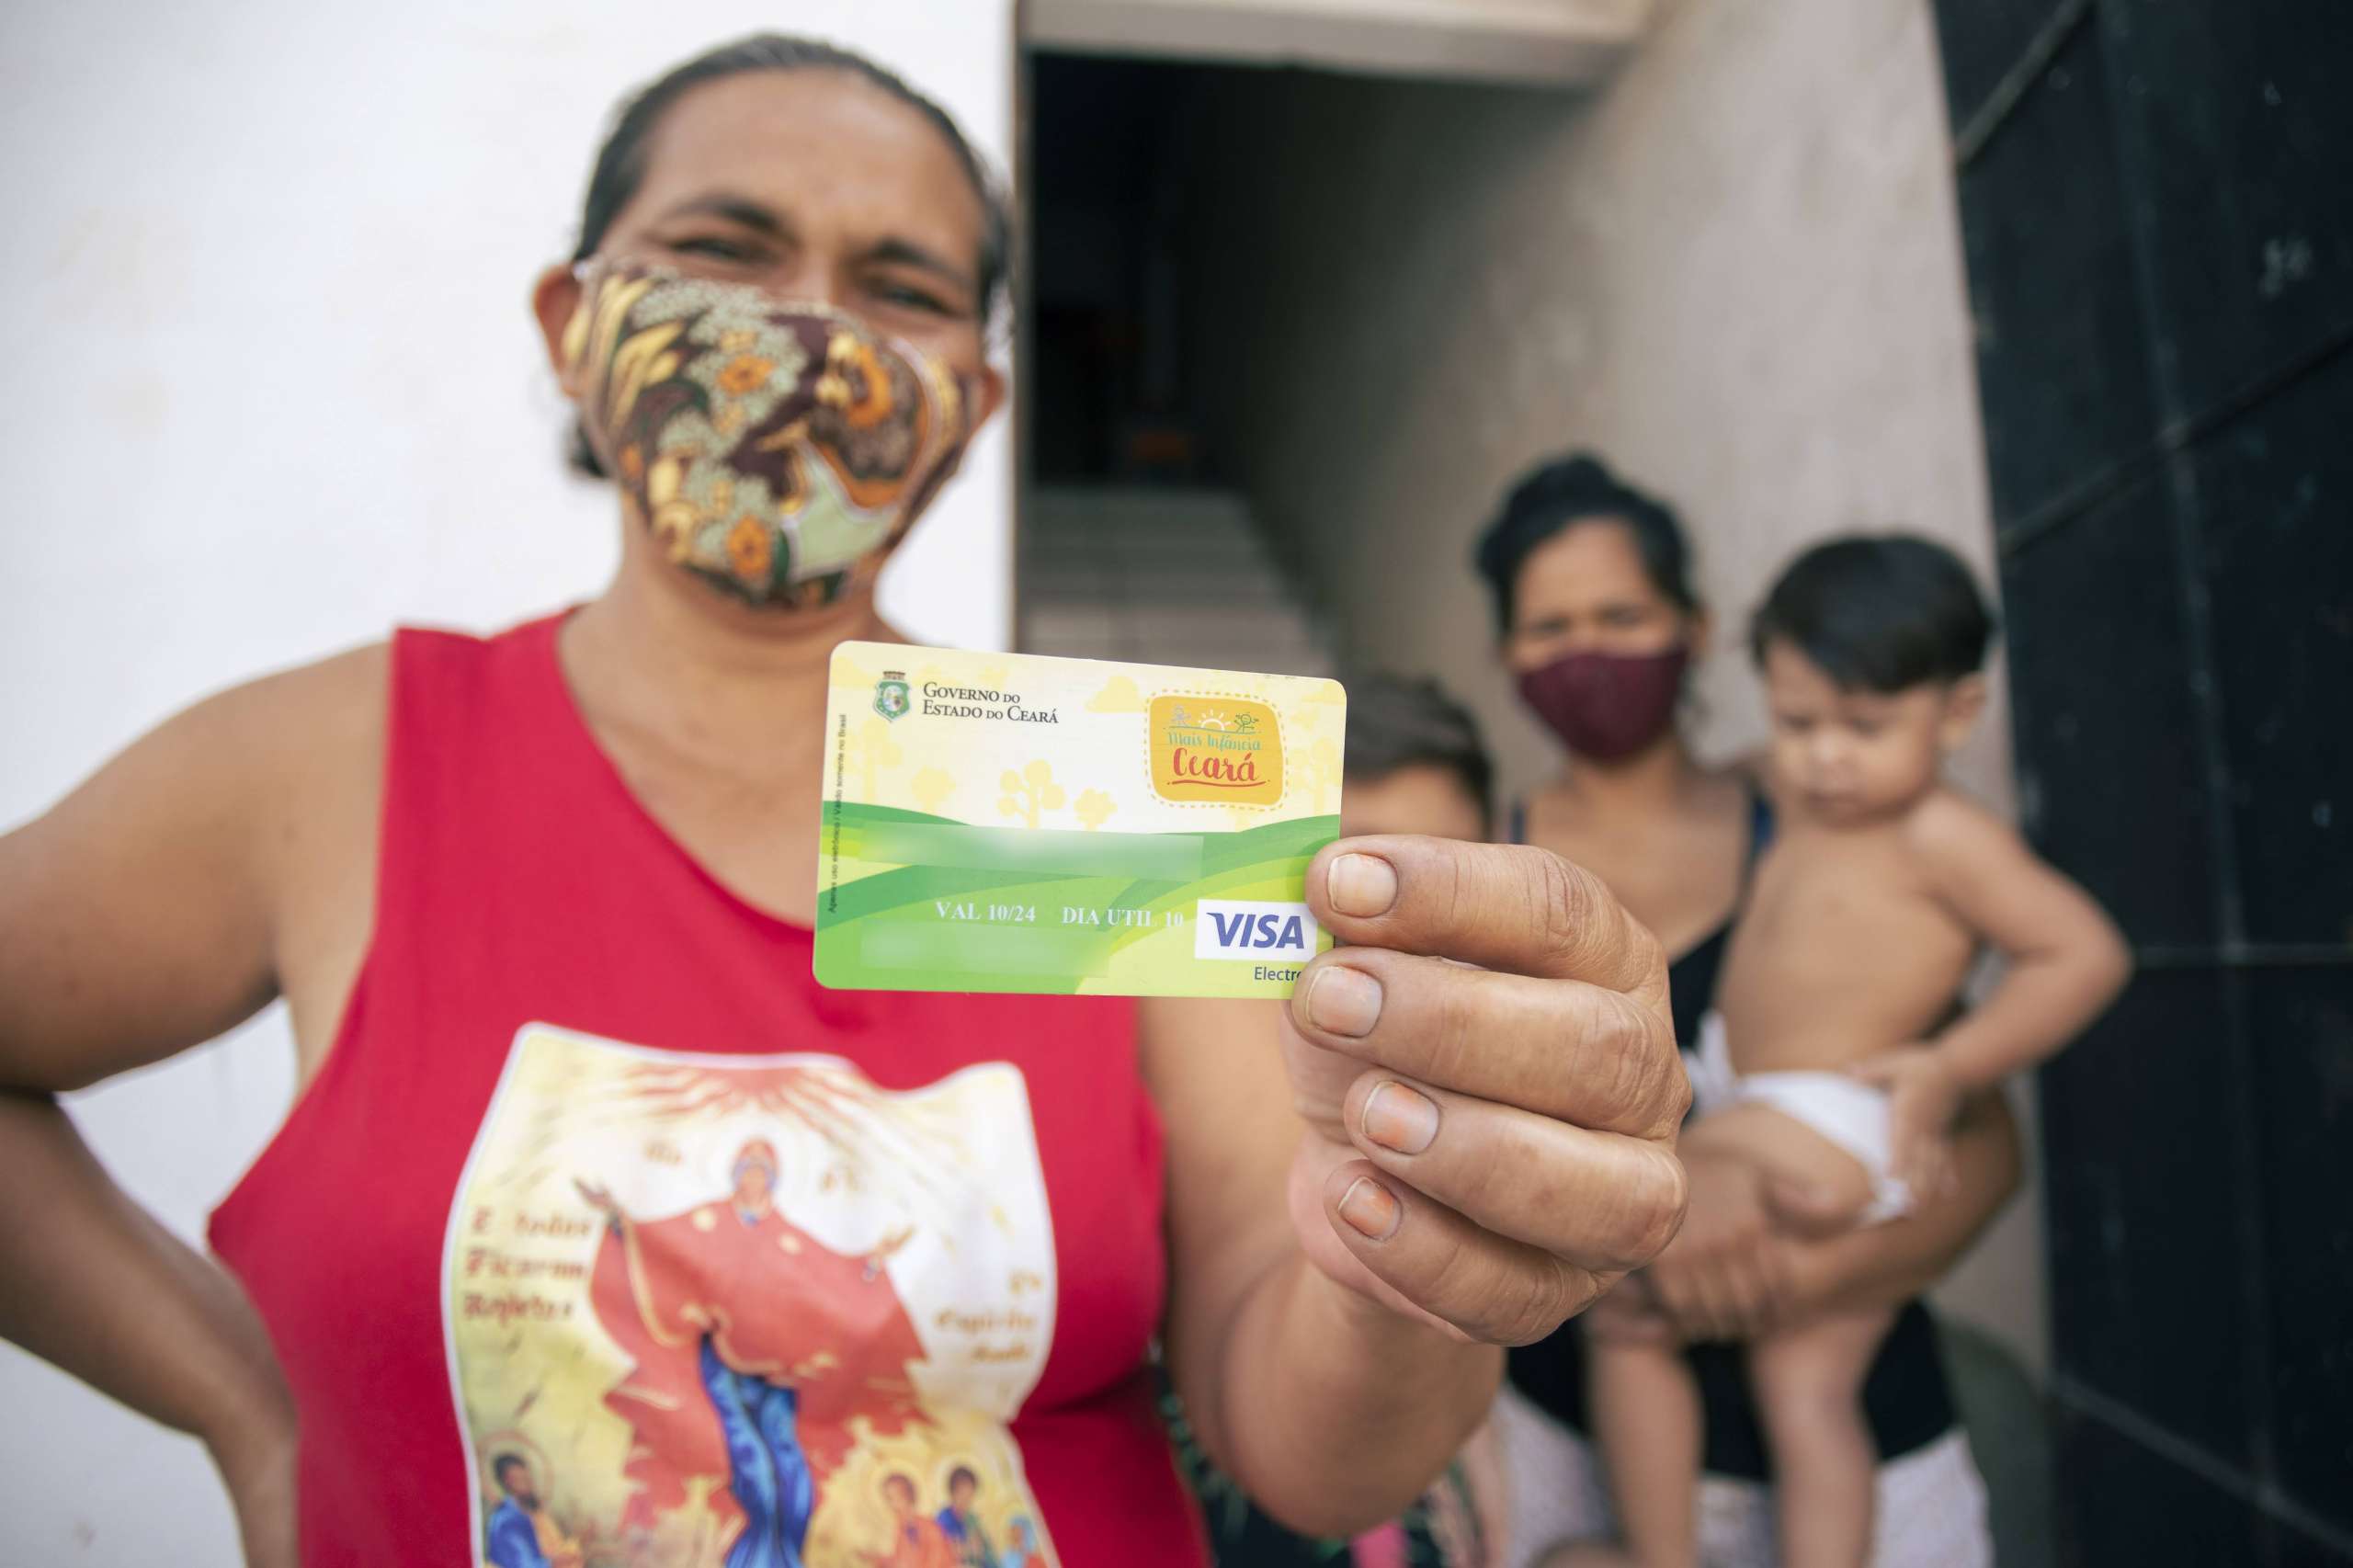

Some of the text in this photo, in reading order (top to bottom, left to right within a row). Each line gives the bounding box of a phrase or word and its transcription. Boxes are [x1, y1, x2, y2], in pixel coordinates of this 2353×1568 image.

[923, 681, 1000, 702] GOVERNO
[922, 699, 983, 719] ESTADO
[1006, 705, 1060, 724] CEARÁ
[837, 713, 847, 737] Brasil
[1167, 732, 1202, 746] Mais
[836, 753, 845, 787] somente
[1173, 747, 1260, 782] Ceará
[935, 901, 981, 921] VAL
[987, 903, 1037, 923] 10/24
[1062, 906, 1100, 926] DIA
[1165, 911, 1185, 928] 10
[1206, 912, 1304, 949] VISA
